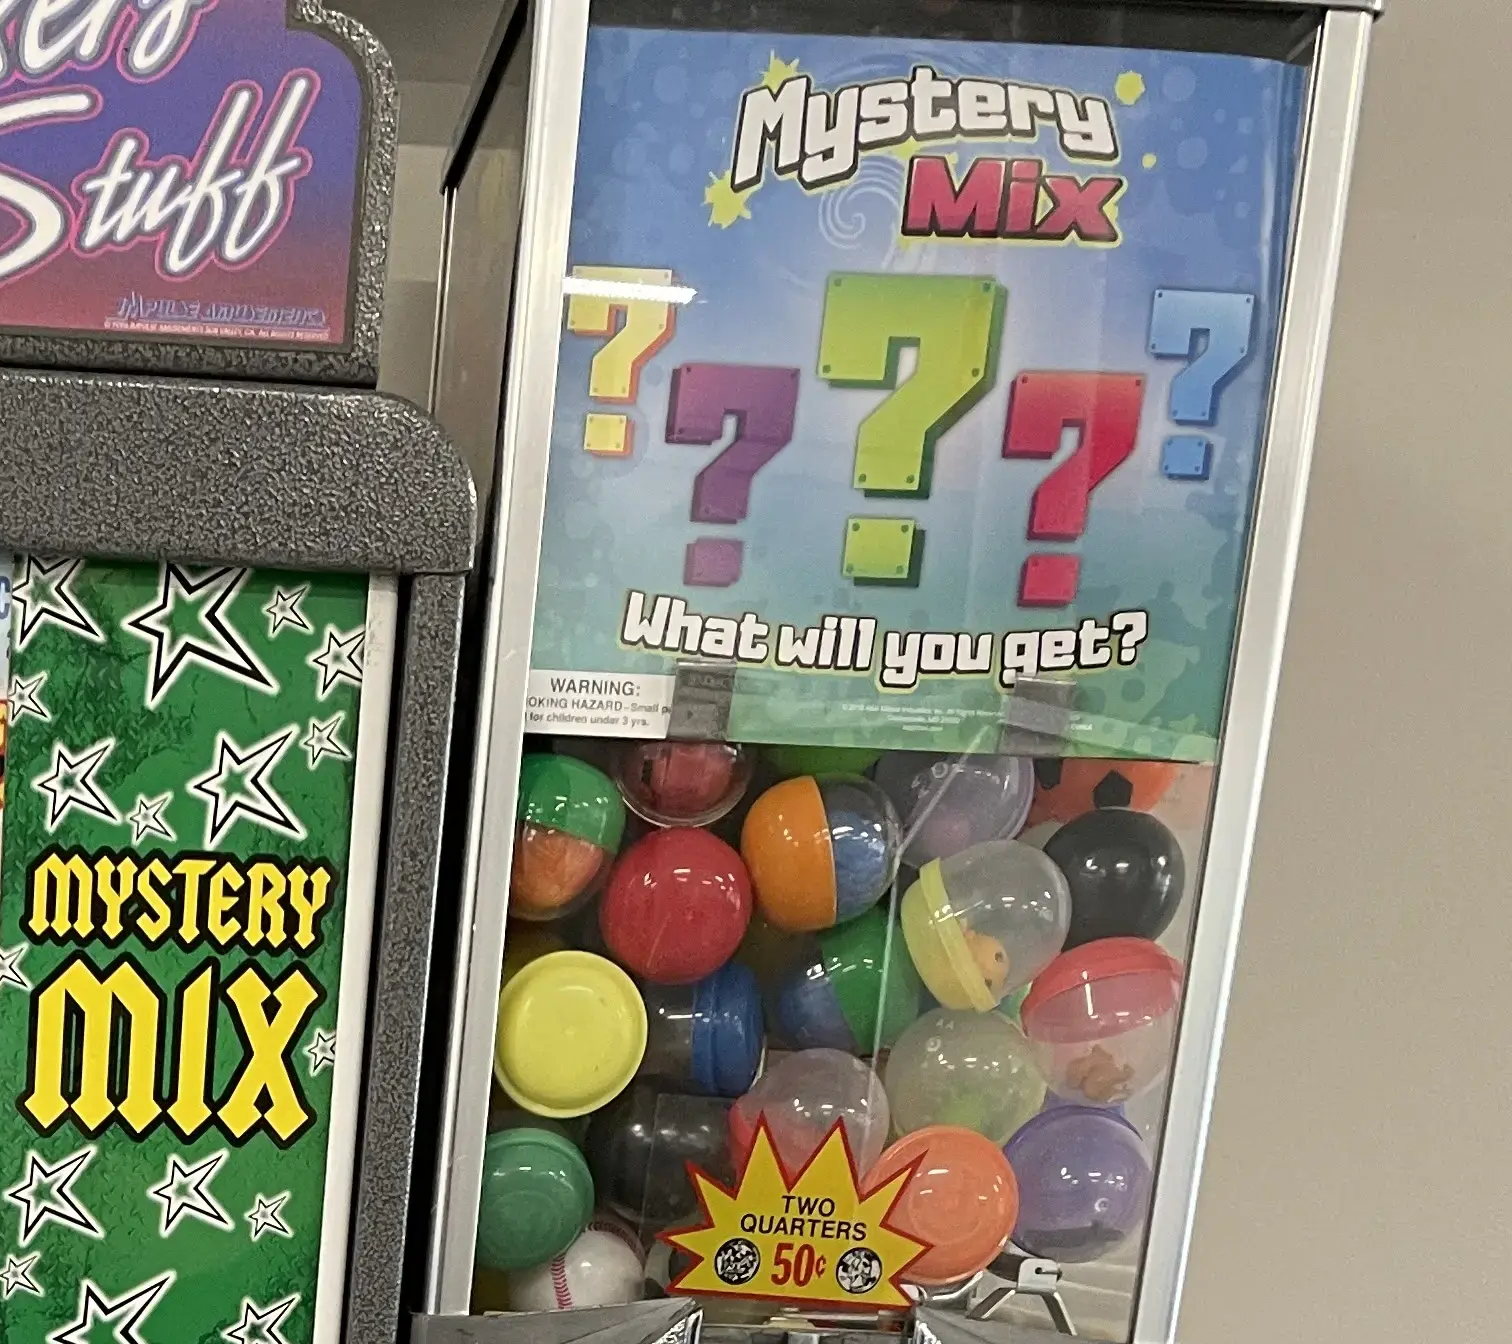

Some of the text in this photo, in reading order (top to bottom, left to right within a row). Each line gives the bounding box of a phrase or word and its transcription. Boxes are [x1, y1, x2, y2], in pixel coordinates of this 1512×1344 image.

[732, 66, 1119, 192] Mystery
[903, 157, 1123, 241] Mix
[622, 591, 1148, 689] What will you get?
[529, 712, 543, 722] for
[546, 713, 587, 724] children
[589, 716, 620, 725] under
[550, 678, 641, 697] WARNING:
[26, 850, 333, 950] MYSTERY
[23, 958, 320, 1143] MIX
[740, 1213, 867, 1242] QUARTERS
[781, 1195, 835, 1217] TWO
[770, 1243, 827, 1288] 50¢
